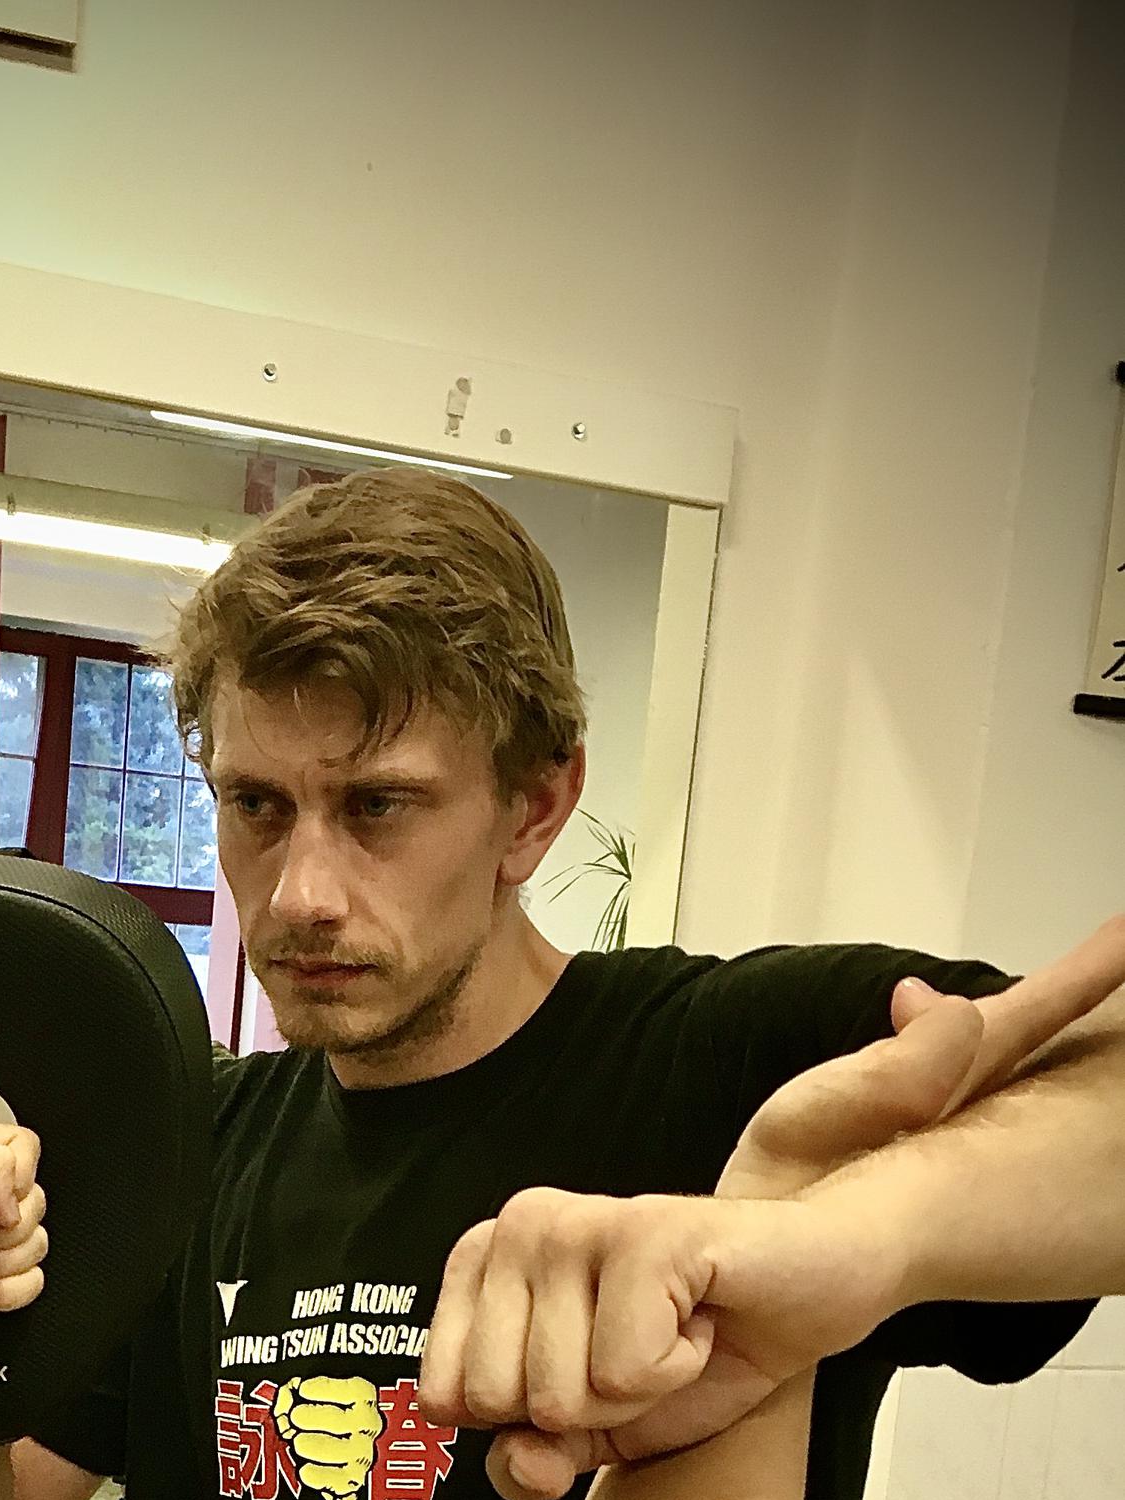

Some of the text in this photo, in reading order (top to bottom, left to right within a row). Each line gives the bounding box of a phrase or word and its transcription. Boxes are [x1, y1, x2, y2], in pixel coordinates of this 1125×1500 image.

[291, 1282, 417, 1319] HONG KONG
[220, 1335, 278, 1368] WING
[281, 1323, 329, 1361] TSUN
